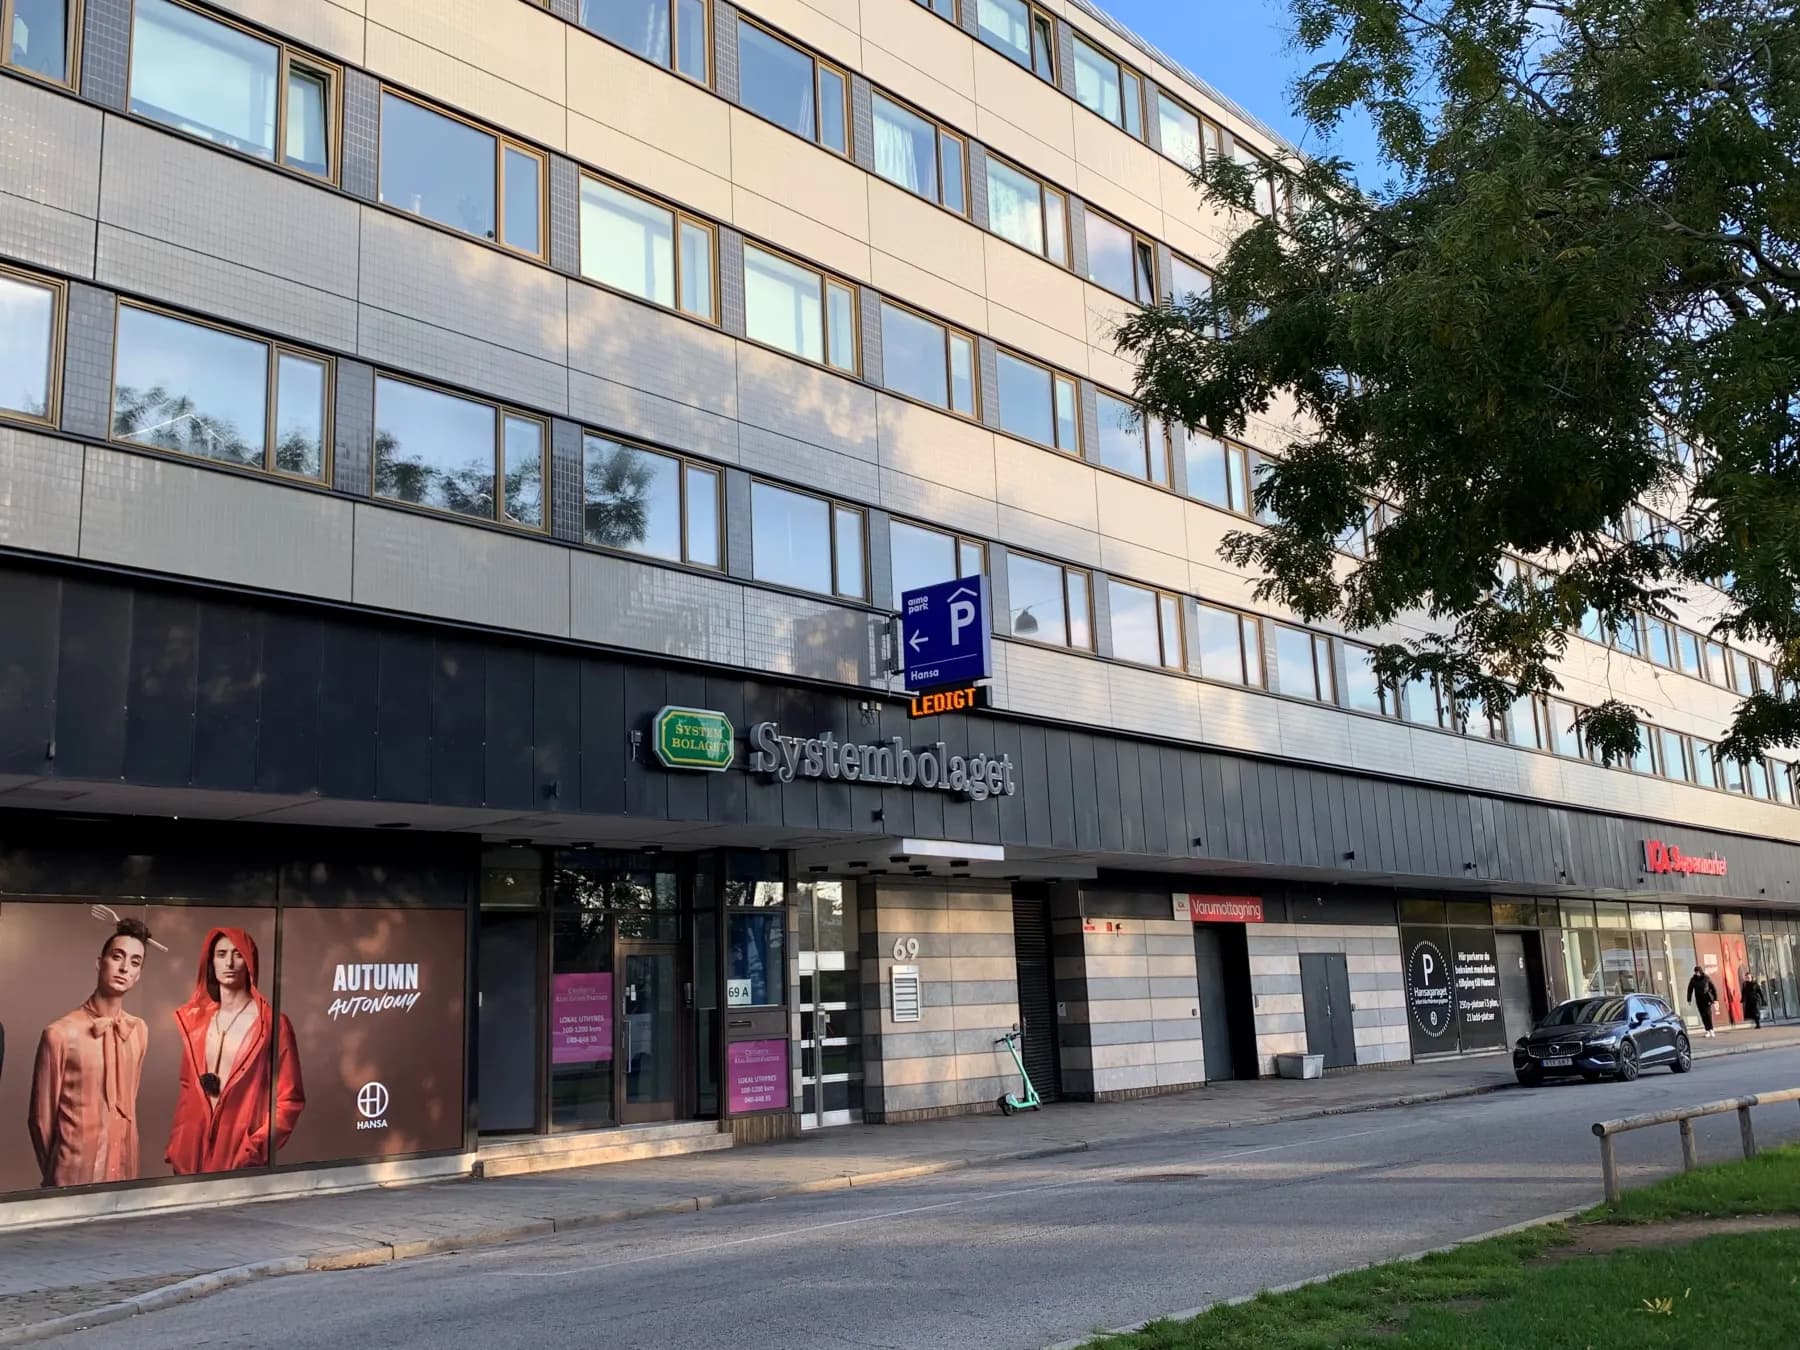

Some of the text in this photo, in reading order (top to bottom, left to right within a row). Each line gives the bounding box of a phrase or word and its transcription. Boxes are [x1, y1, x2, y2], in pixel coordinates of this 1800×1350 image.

[908, 595, 928, 606] aimo
[908, 603, 928, 615] park
[950, 600, 976, 646] P
[911, 669, 939, 681] Hansa
[911, 688, 976, 717] LEDIGT
[675, 723, 723, 738] SYSTEM
[672, 738, 726, 753] BOLAGET
[750, 721, 1015, 800] Systembolaget
[1192, 899, 1261, 920] Varumottagning
[893, 937, 919, 961] 69
[333, 963, 418, 992] AUTUMN
[1422, 954, 1434, 986] P
[728, 987, 749, 998] 69 A
[1414, 987, 1448, 999] Hansagaraget
[328, 991, 421, 1021] AUTONOMY
[356, 1120, 388, 1130] HANSA
